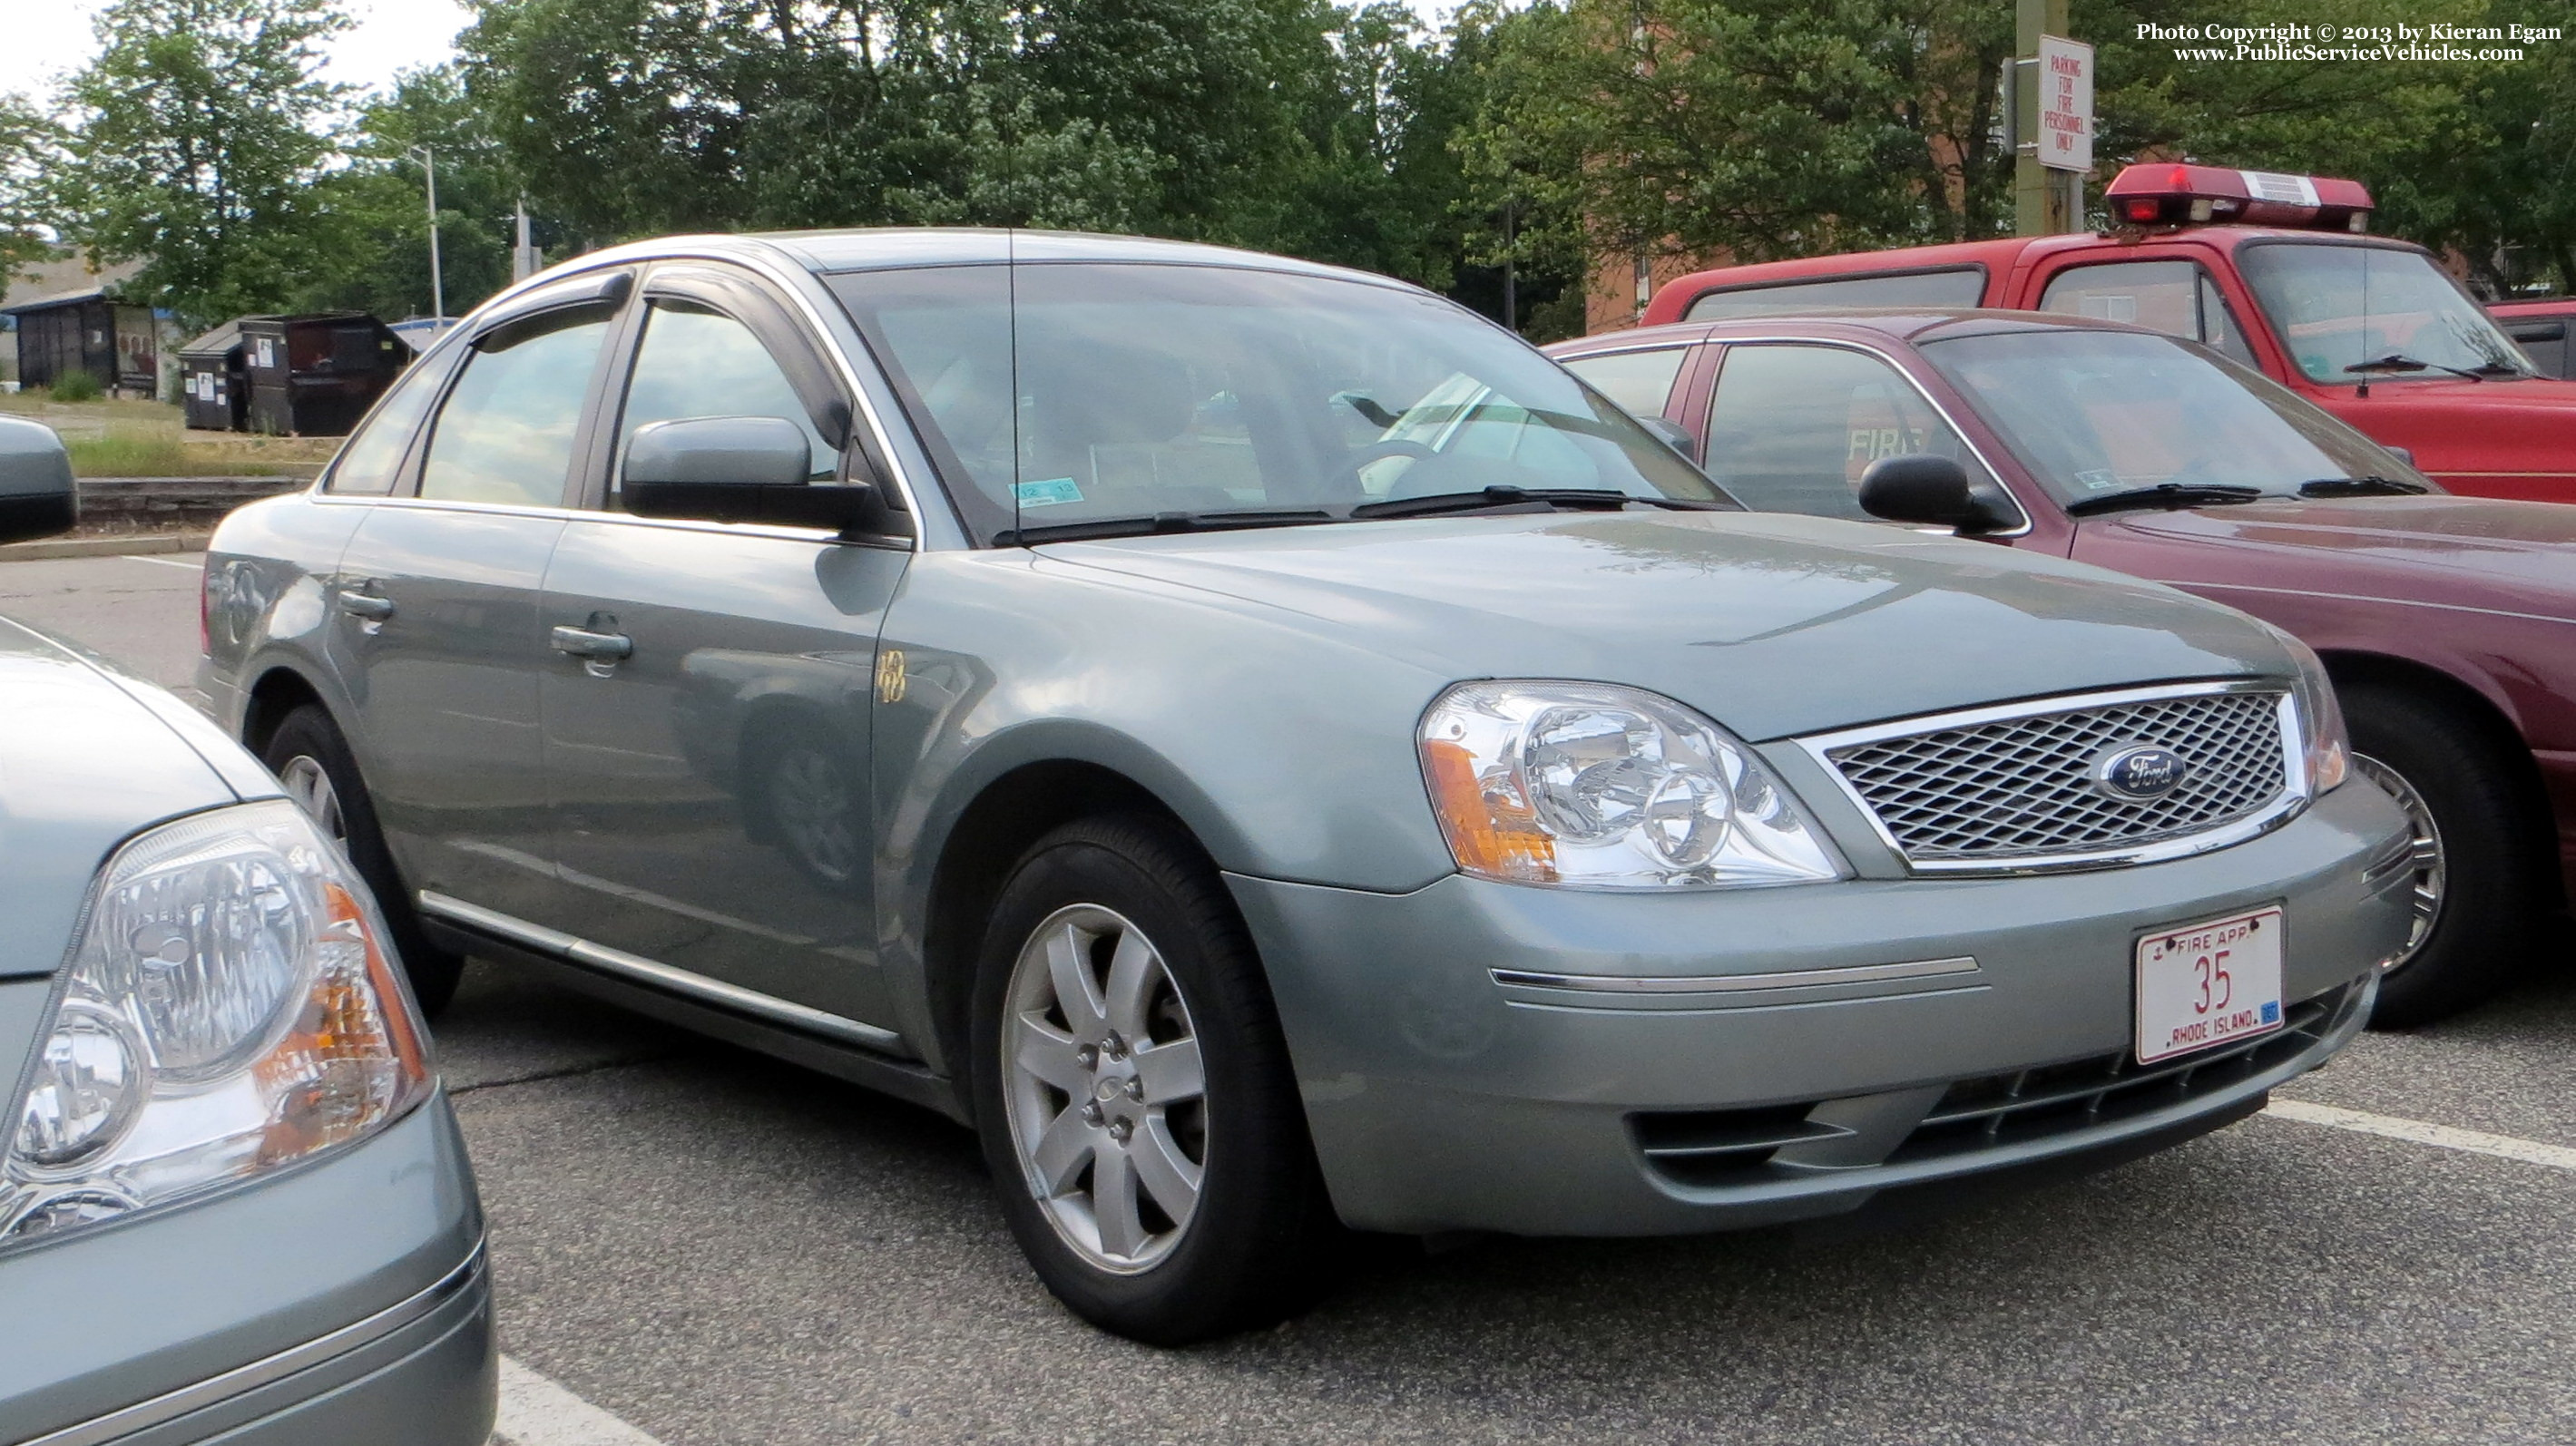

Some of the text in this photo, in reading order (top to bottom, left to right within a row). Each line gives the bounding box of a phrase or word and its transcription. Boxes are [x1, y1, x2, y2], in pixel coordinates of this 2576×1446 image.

[2051, 54, 2081, 77] PARKING
[2059, 76, 2073, 94] FOR
[2057, 94, 2073, 113] FIRE
[2044, 111, 2085, 134] PERSONNEL
[2056, 132, 2074, 151] ONLY
[2129, 754, 2173, 788] Ford
[2178, 933, 2211, 953] FIRE
[2194, 950, 2230, 1013] 35
[2172, 1021, 2209, 1045] RHODE
[2214, 1010, 2253, 1034] ISLAND
